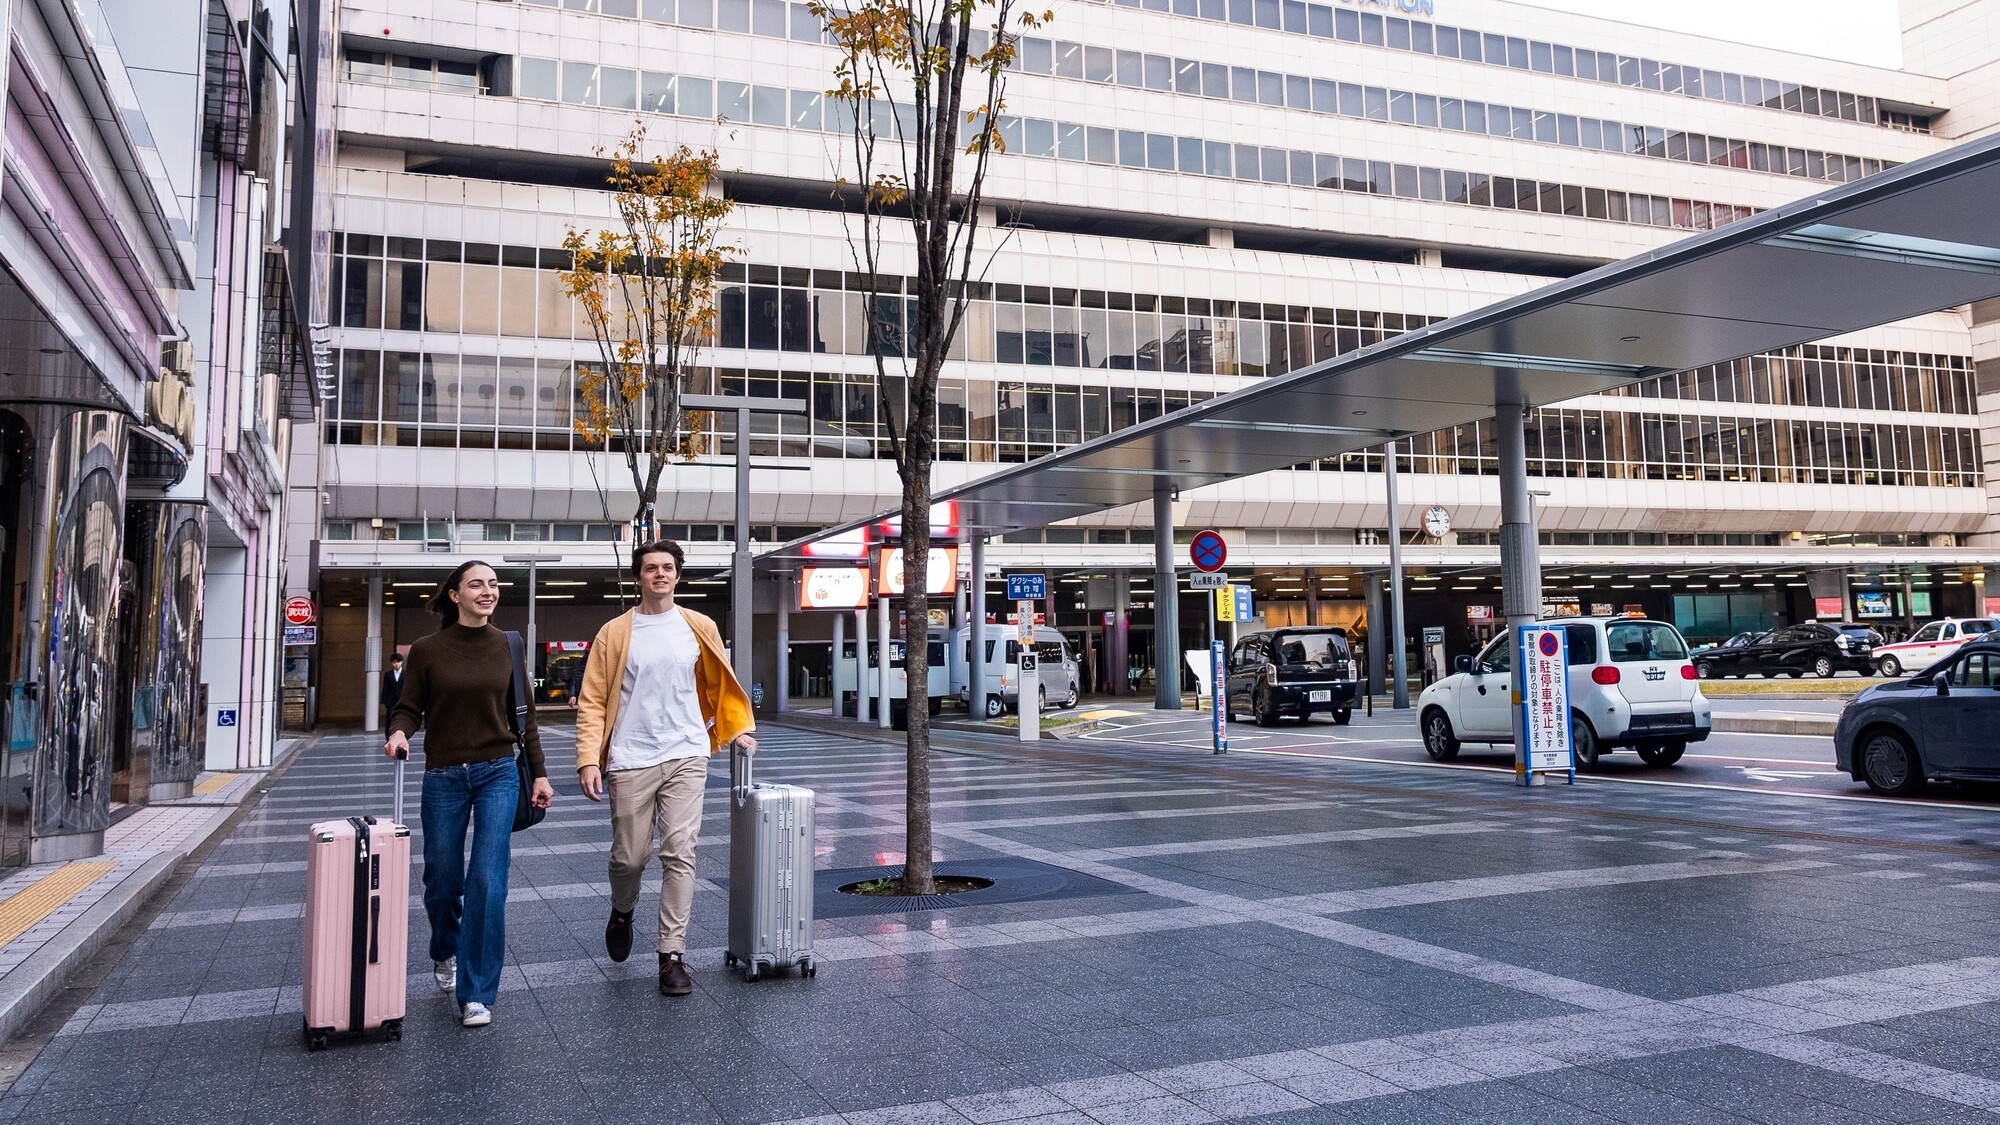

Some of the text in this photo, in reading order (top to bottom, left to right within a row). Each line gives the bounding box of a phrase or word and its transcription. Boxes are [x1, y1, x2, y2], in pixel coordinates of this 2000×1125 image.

[1011, 577, 1042, 585] タクシーのみ
[1193, 576, 1225, 586] 人の乗降を除く
[1528, 633, 1540, 748] 警察の取締りの対象となります
[1554, 659, 1564, 748] ここは、人の乗降を除き
